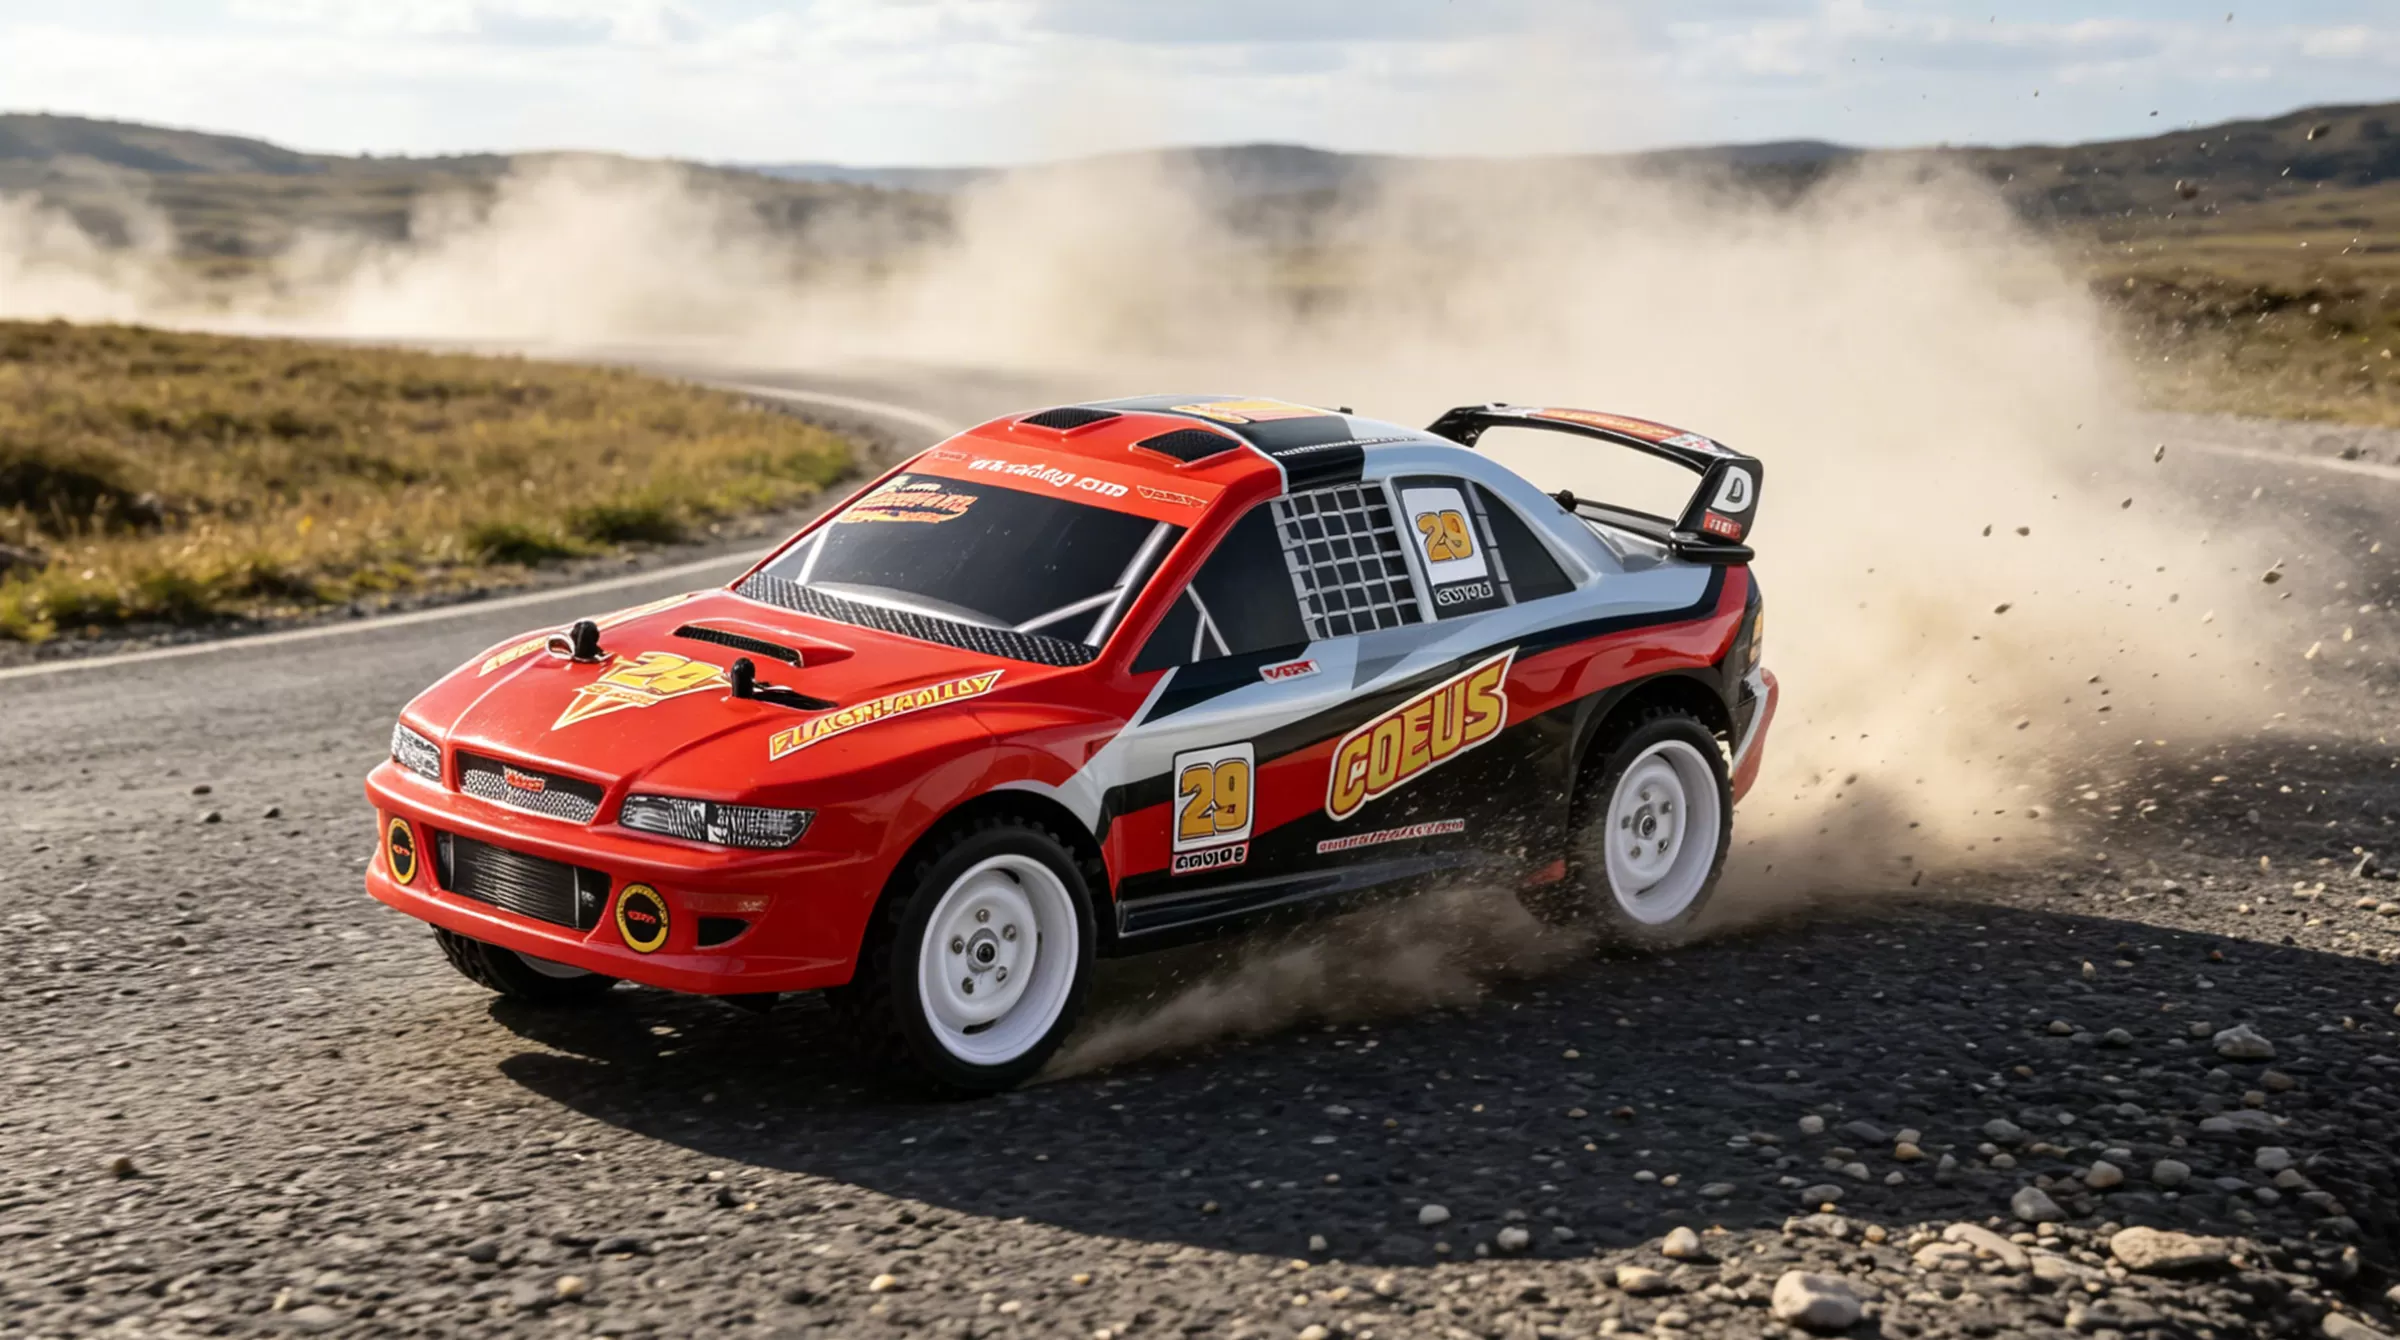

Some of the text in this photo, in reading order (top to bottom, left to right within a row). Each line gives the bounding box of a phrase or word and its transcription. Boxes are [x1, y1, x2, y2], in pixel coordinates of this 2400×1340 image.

[1711, 465, 1753, 513] D
[1416, 509, 1474, 564] 29
[597, 651, 725, 695] 29
[1329, 658, 1504, 818] COEUS
[1179, 757, 1250, 842] 29
